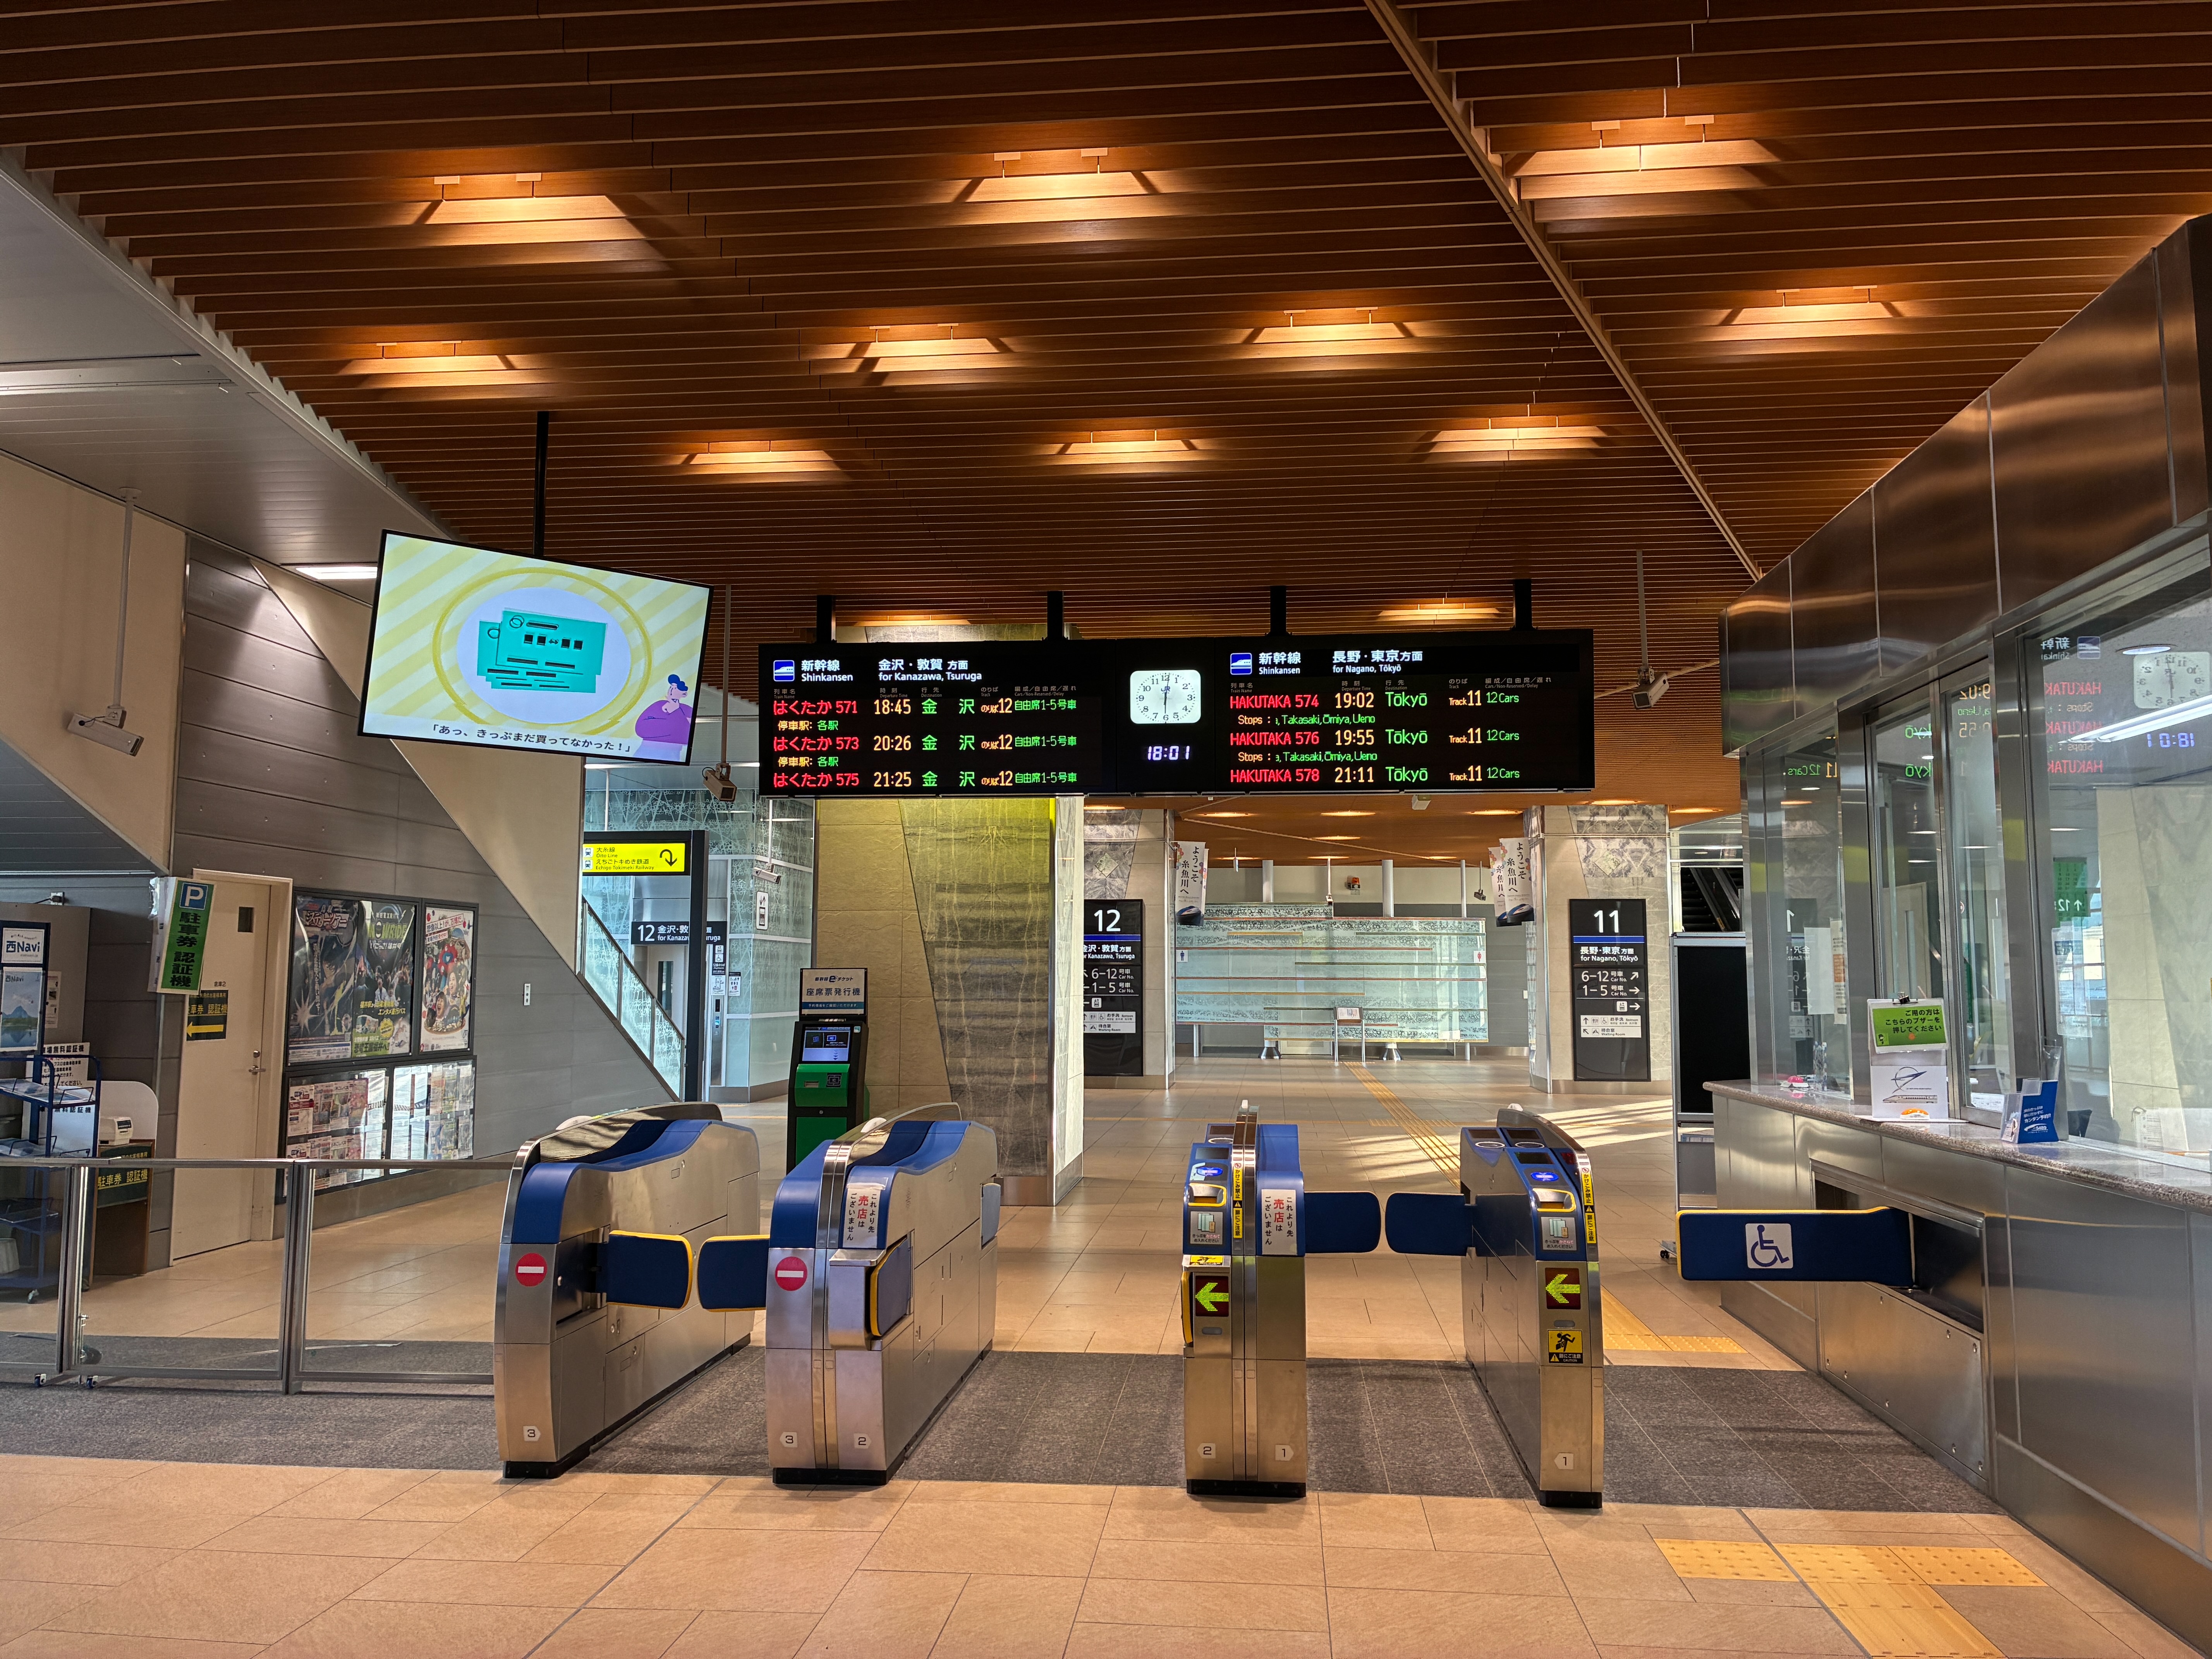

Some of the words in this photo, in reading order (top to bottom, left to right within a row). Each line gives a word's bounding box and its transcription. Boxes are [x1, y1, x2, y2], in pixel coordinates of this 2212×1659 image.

[802, 659, 840, 671] 新幹線
[879, 659, 942, 670] 金沢・敦賀
[948, 660, 968, 670] 方面
[1259, 652, 1301, 665] 新幹線
[1346, 665, 1376, 674] Nagano,
[1379, 664, 1401, 673] Tōkyō
[802, 673, 853, 681] Shinkansen
[879, 672, 892, 680] for
[895, 673, 943, 681] Kanazawa,
[946, 672, 982, 682] Tsuruga
[774, 700, 832, 715] はくたか
[836, 701, 857, 713] 571
[874, 699, 910, 714] 18:45
[1015, 699, 1076, 710] 自由席1-5号車
[1230, 695, 1291, 709] HAKUTAKA
[1295, 695, 1319, 708] 574
[1335, 692, 1374, 708] 19:02
[1385, 692, 1427, 707] Tōkyō
[817, 720, 838, 730] 各駅
[1238, 715, 1262, 725] Stops
[774, 736, 832, 751] はくたか
[836, 737, 859, 750] 573
[874, 735, 911, 750] 20:26
[1015, 736, 1076, 747] 自由席1-5号車
[1230, 732, 1291, 745] HAKUTAKA
[1296, 732, 1319, 744] 576
[1336, 730, 1374, 745] 19:55
[1386, 729, 1427, 745] Tōkyō
[1147, 745, 1190, 761] 18:01
[1238, 752, 1262, 762] Stops
[818, 757, 838, 766] 各駅
[774, 773, 832, 787] はくたか
[836, 773, 859, 786] 575
[874, 772, 911, 787] 21:25
[1015, 772, 1077, 783] 自由席1-5号車
[1231, 769, 1291, 782] HAKUTAKA
[1296, 769, 1319, 781] 578
[1335, 767, 1374, 782] 21:11
[1386, 767, 1427, 782] Tōkyō
[1191, 846, 1199, 882] ようこそ
[1517, 842, 1527, 879] ようこそ
[1180, 860, 1190, 894] 糸魚川へ
[1507, 857, 1518, 892] 糸魚川へ
[185, 886, 203, 907] P
[1094, 909, 1121, 932] 12
[1594, 910, 1620, 933] 11
[176, 912, 201, 948] 駐車券
[638, 924, 655, 941] 12
[6, 941, 40, 953] 西Navi
[1580, 946, 1634, 955] 長野・東京方面
[170, 951, 195, 987] 認証機
[807, 988, 860, 996] 座席票発行機
[1886, 1017, 1940, 1025] こちらのブザーを
[1893, 1025, 1941, 1034] 押してください
[847, 1193, 857, 1241] ございません
[857, 1195, 869, 1228] 売店は
[868, 1194, 877, 1233] これより先
[1273, 1198, 1285, 1232] 売店は
[1286, 1197, 1294, 1238] これより先
[1264, 1196, 1272, 1245] ございません
[527, 1429, 535, 1437] 3
[786, 1435, 793, 1443] 3
[858, 1437, 866, 1445] 2
[1203, 1446, 1212, 1455] 2
[1281, 1449, 1285, 1457] 1
[1563, 1457, 1567, 1466] 1
